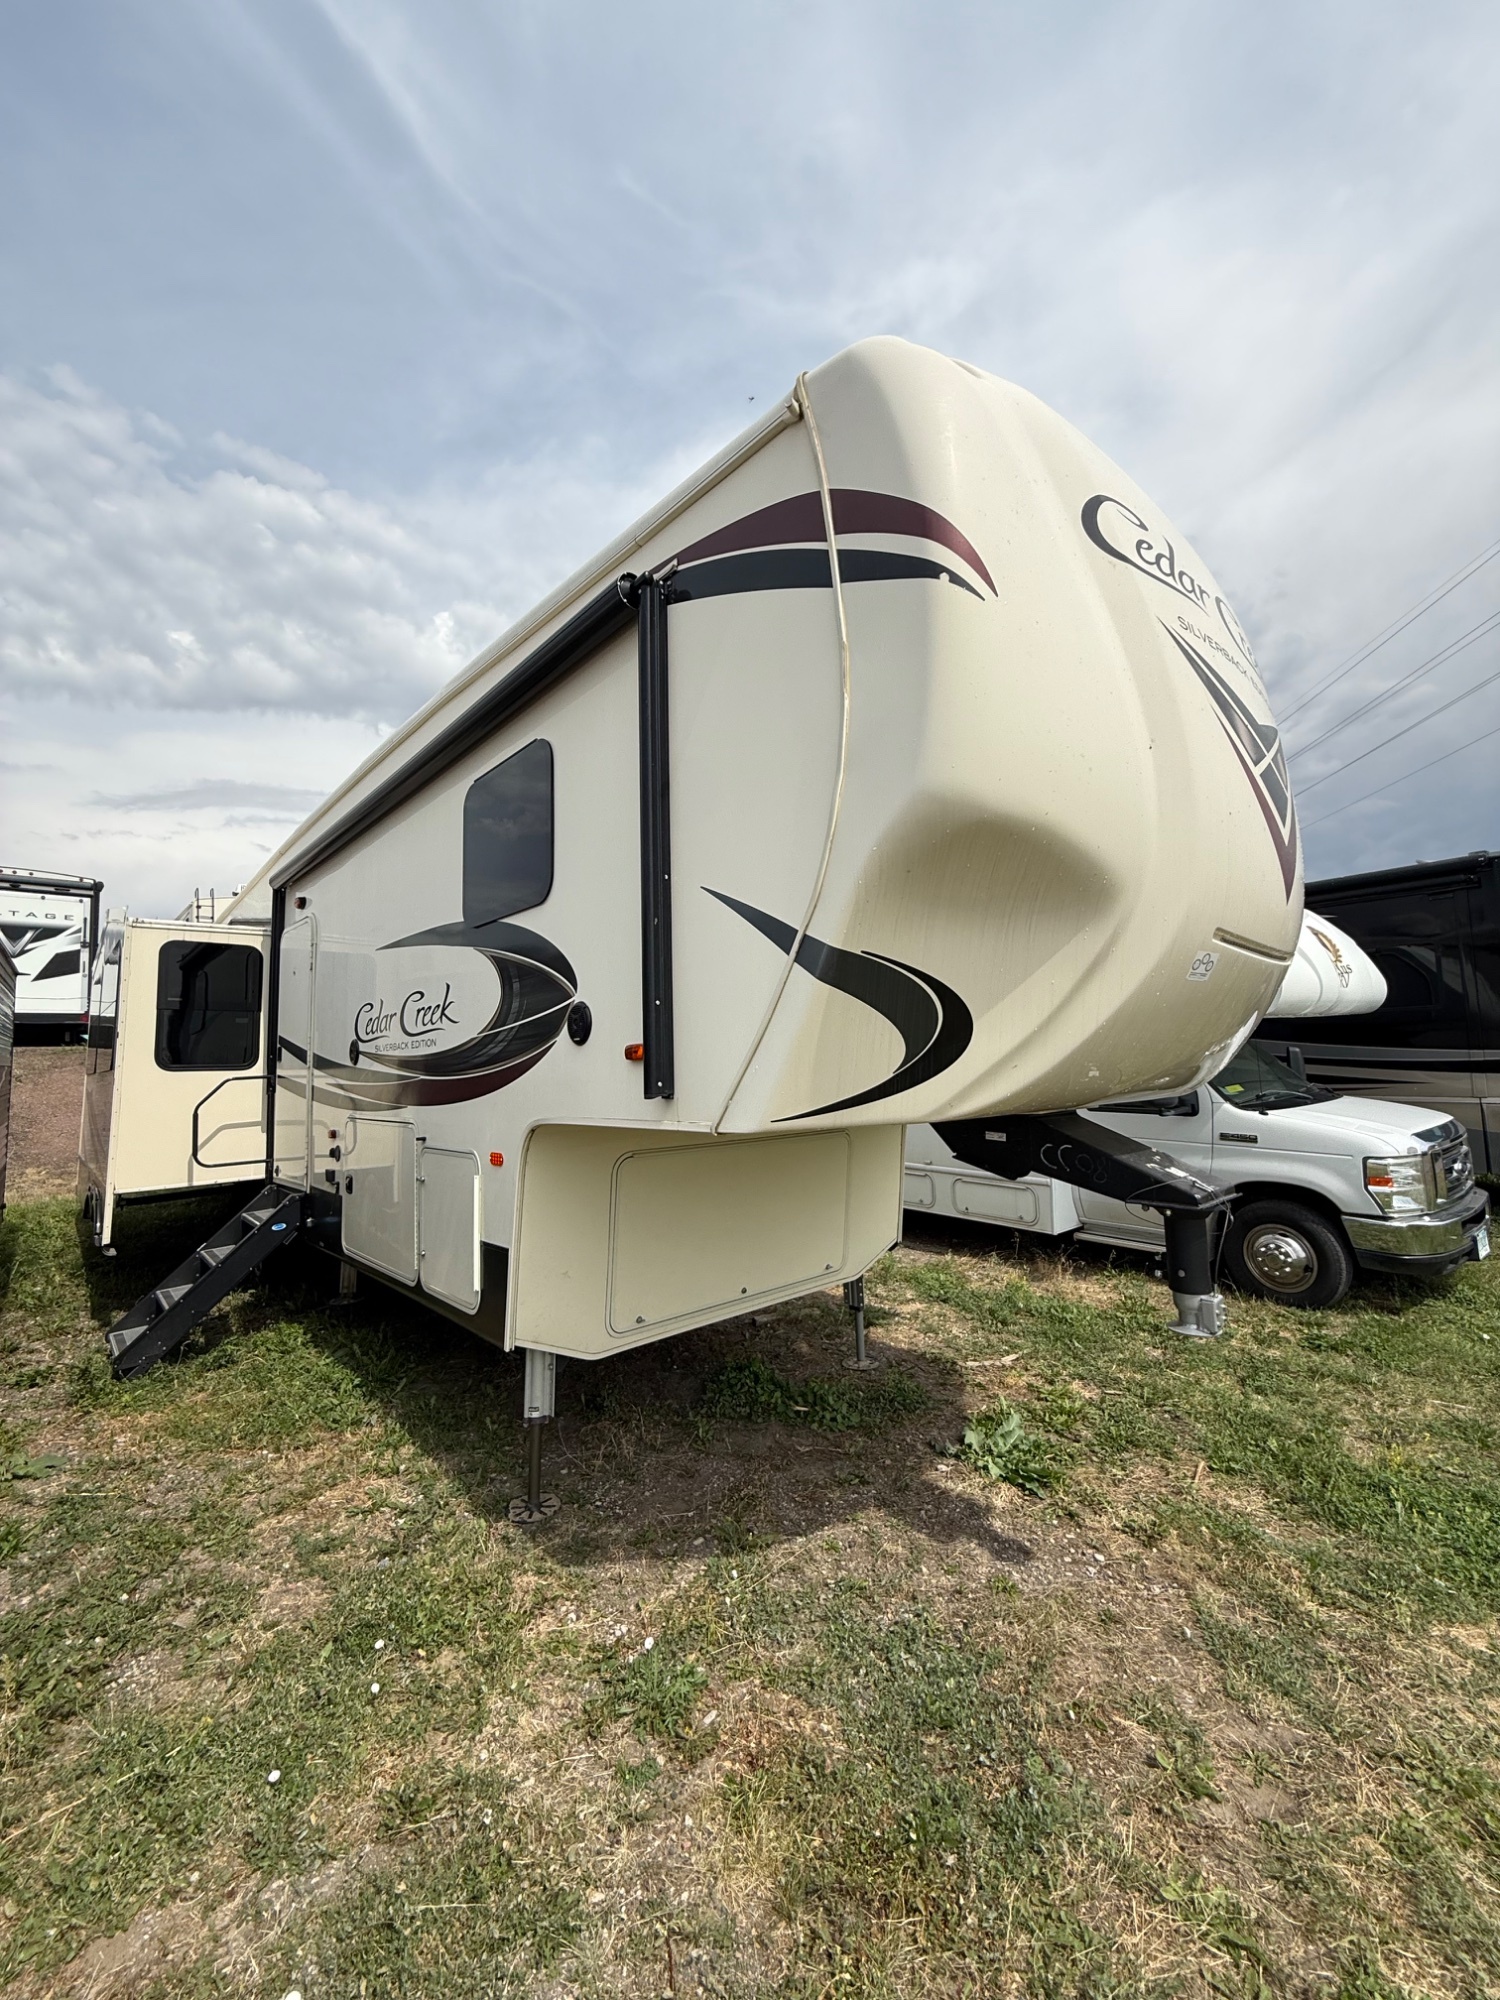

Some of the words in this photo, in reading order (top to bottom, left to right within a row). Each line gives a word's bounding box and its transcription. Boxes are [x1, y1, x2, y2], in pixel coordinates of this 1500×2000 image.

[1081, 494, 1210, 617] Cedar
[1177, 616, 1249, 680] SILVERBACK
[0, 910, 74, 921] TAGE
[354, 998, 397, 1043] Cedar
[400, 982, 460, 1037] Creek
[375, 1041, 409, 1053] SILVERBACK
[411, 1038, 437, 1049] EDITION
